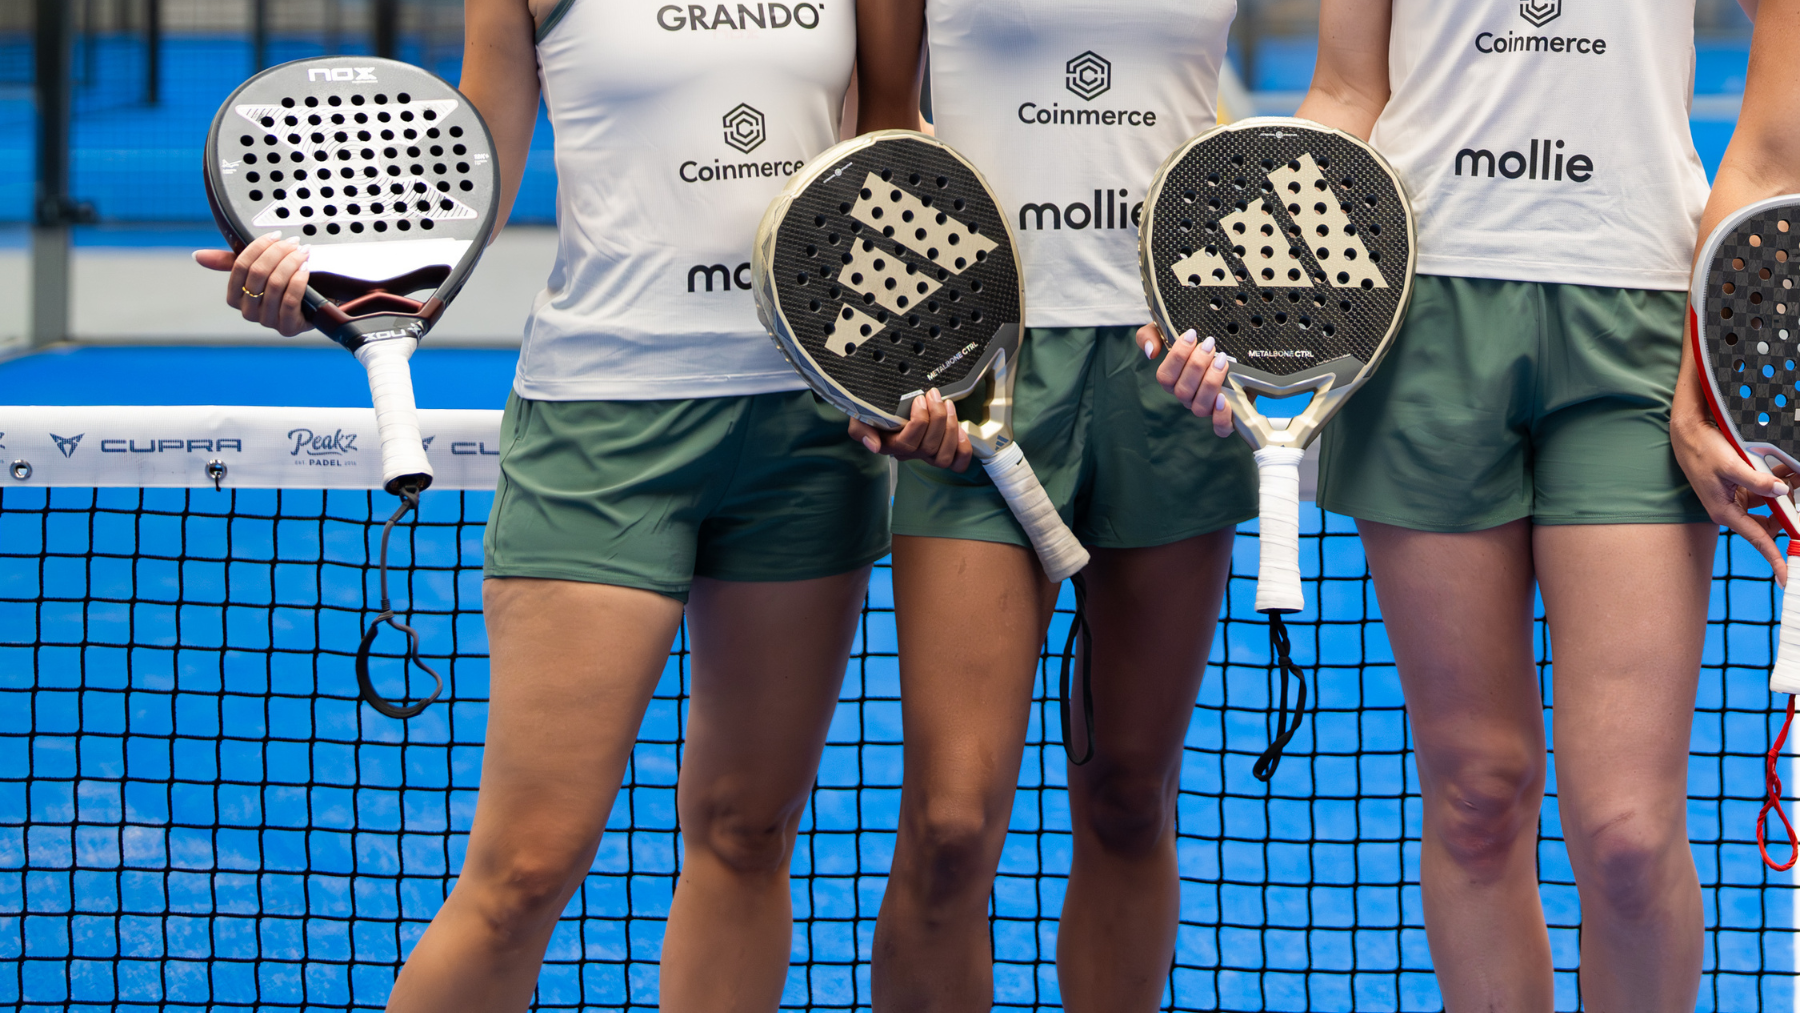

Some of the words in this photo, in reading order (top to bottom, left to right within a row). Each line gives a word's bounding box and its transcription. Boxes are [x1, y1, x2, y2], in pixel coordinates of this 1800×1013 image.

[657, 2, 820, 31] GRANDO
[1475, 30, 1607, 55] Coinmerce
[1018, 102, 1157, 127] Coinmerce
[1454, 138, 1594, 183] mollie
[926, 351, 964, 381] METALBONE
[961, 341, 979, 356] CTRL
[1294, 349, 1315, 358] CTRL
[100, 438, 242, 453] CUPRA
[287, 428, 358, 457] Peakz
[309, 458, 342, 467] PADEL
